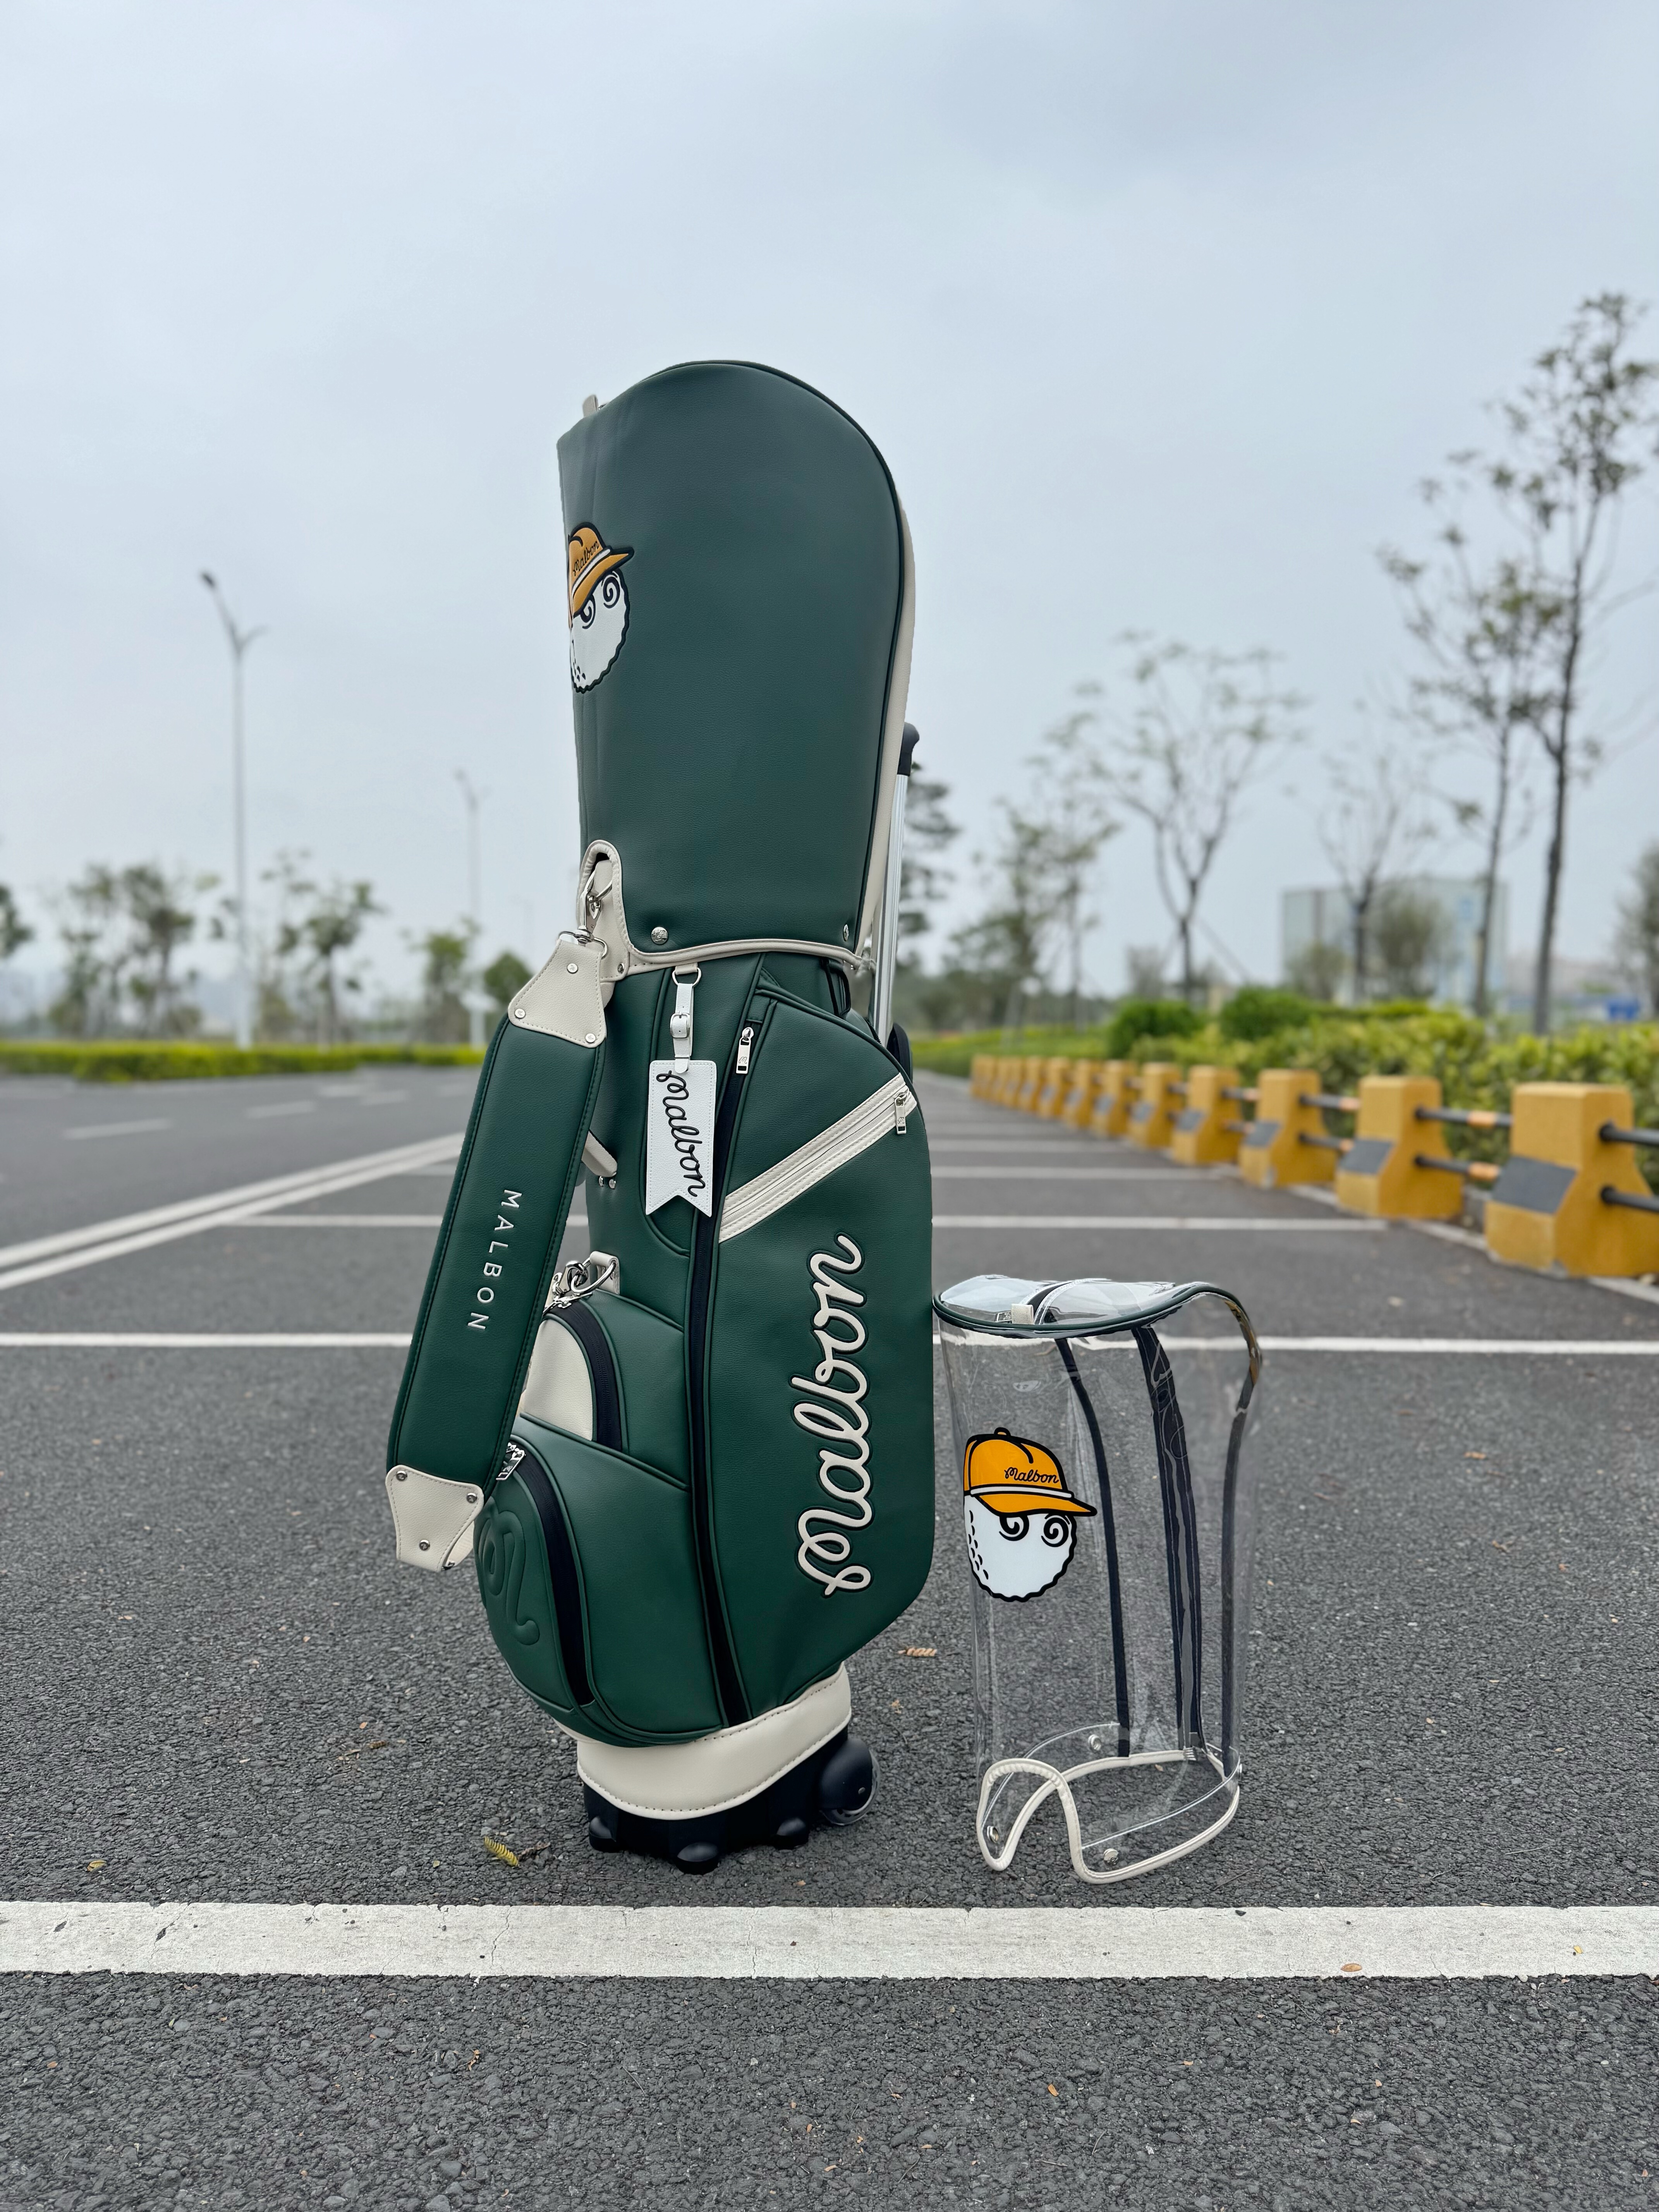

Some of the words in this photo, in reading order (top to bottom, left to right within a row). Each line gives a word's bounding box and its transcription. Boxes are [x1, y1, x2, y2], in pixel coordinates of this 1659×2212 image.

[572, 541, 599, 577] Malbon
[656, 1070, 706, 1197] Malbon
[467, 1190, 522, 1329] MALBON
[791, 1235, 873, 1596] Malbon
[1004, 1467, 1059, 1484] Malbon
